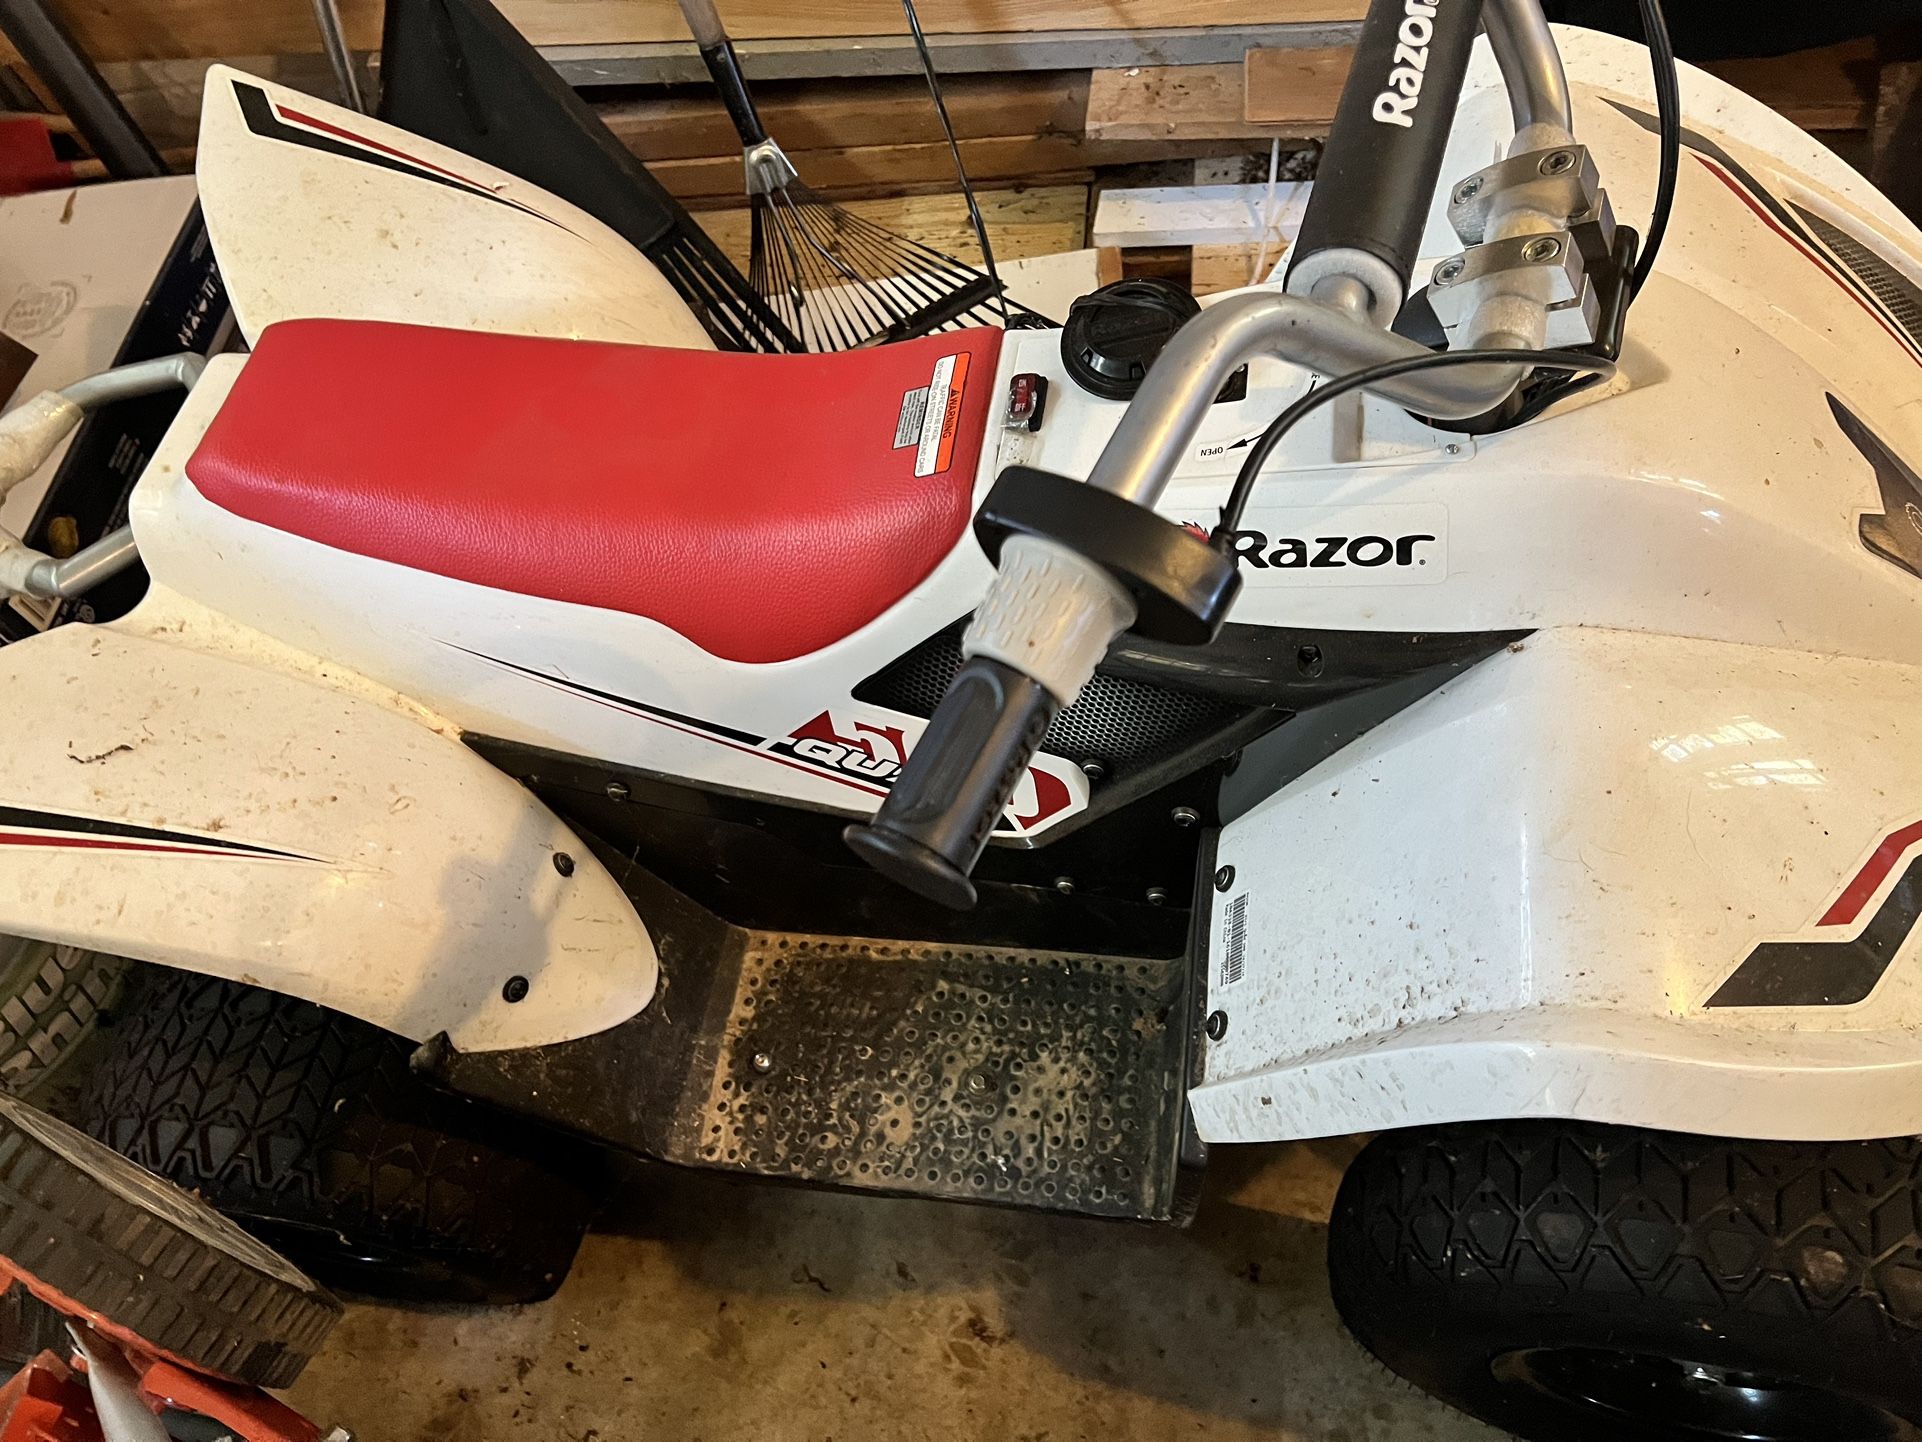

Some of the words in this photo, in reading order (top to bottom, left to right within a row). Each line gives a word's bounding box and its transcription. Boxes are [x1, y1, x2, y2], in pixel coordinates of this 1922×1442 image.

[937, 384, 947, 405] TRAFFIC
[925, 401, 935, 424] STREETS
[935, 405, 943, 417] CAN
[942, 397, 957, 438] WARNING
[930, 425, 939, 442] FATAL
[919, 434, 930, 457] AROUND
[1200, 446, 1224, 457] OPEN
[916, 457, 925, 473] CARS
[1232, 530, 1436, 568] Razor
[792, 737, 906, 784] QU
